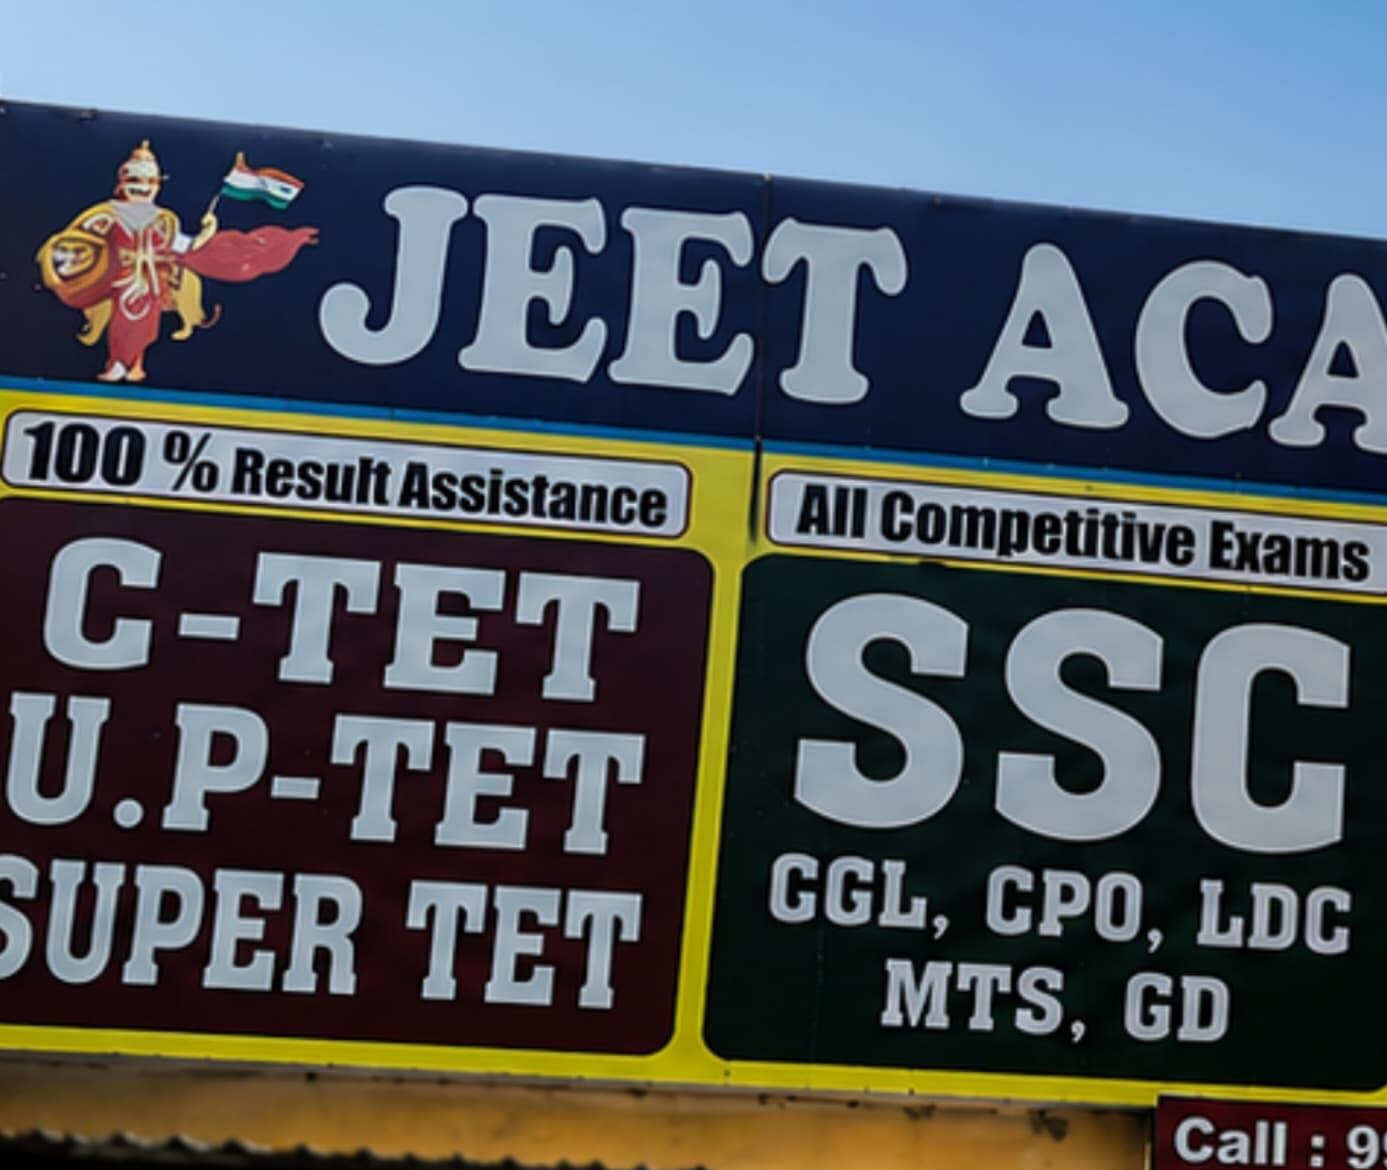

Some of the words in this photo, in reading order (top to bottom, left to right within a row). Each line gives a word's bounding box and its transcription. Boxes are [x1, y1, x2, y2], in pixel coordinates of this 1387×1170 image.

[318, 186, 907, 403] JEET
[23, 420, 145, 487] 100
[231, 445, 391, 508] Result
[403, 462, 668, 529] Assistance
[797, 483, 870, 541] All
[881, 489, 1195, 567] Competitive
[1208, 517, 1371, 583] Exams
[43, 536, 641, 703] C-TET
[5, 692, 645, 855] U.P-TET
[793, 592, 1352, 855] SSC
[405, 878, 643, 1010] TET
[768, 852, 949, 940] CGL,
[985, 864, 1163, 951] CPO,
[1197, 879, 1351, 955] LDC
[881, 958, 1086, 1042] MTS,
[1123, 973, 1231, 1043] GD
[1174, 1116, 1287, 1168] Call
